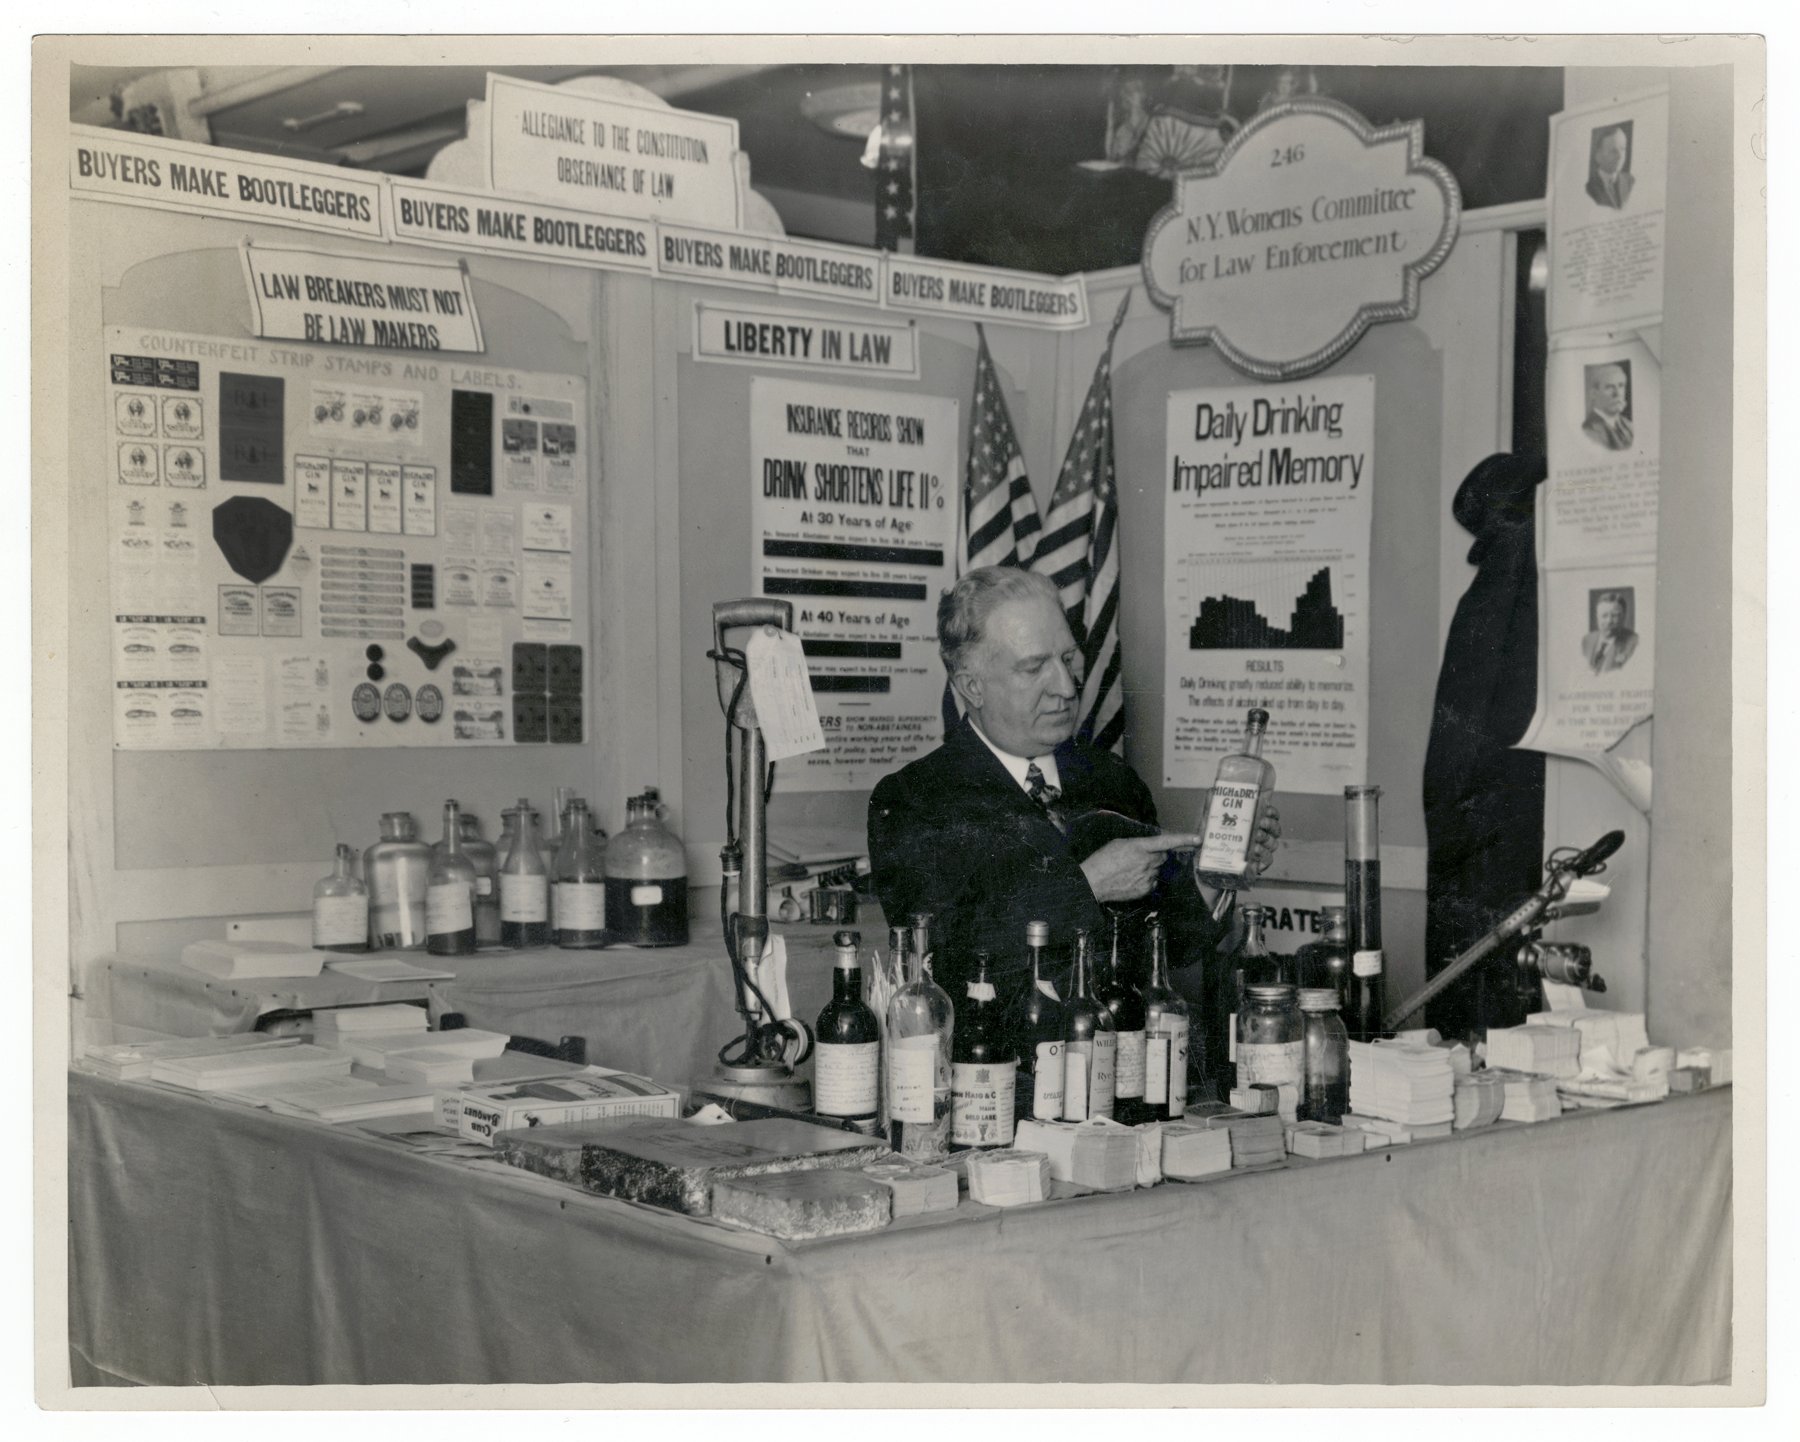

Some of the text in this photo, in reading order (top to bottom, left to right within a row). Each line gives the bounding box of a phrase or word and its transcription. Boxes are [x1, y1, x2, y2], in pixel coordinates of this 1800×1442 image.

[522, 110, 708, 164] ALLEGIANCE TO THE CONSTITUTION
[1270, 144, 1305, 168] 246
[78, 149, 372, 223] BUYERS MAKE BOOTLEGGERS
[557, 156, 674, 199] OBSERVANCE OF LAW
[400, 198, 648, 258] BUYERS MAKE BOOTLEGGERS
[1227, 205, 1304, 239] Womens
[1312, 186, 1416, 223] Committee
[664, 235, 874, 291] BUYERS MAKE BOOTLEGGERS
[1179, 227, 1408, 285] for Law Enforcement
[260, 273, 464, 317] LAW BREAKERS MUST NOT
[893, 272, 1078, 316] BUYERS MAKE BOOTLEGGERS
[304, 313, 440, 349] BE LAW MAKERS
[724, 319, 892, 364] LIBERTY IN LAW
[140, 335, 257, 362] COUNTERFEIT
[269, 351, 314, 368] STRIP
[324, 356, 392, 377] STAMPS
[403, 364, 438, 382] AND
[786, 403, 925, 446] INSURANCE RECORDS SHOW
[1195, 395, 1344, 447] Daily Drinking
[846, 445, 870, 457] THAT
[1173, 447, 1365, 498] Impaired Memory
[763, 457, 808, 500] DRINK
[814, 463, 883, 505] SHORTENS
[889, 469, 915, 509] LIFE
[800, 511, 912, 533] At 30 Years of Age
[800, 610, 910, 629] At 40 Years of Age
[1180, 676, 1196, 692] Daily
[1198, 677, 1227, 692] Drinking
[1228, 677, 1252, 692] greatly
[1255, 678, 1284, 691] reduced
[1286, 678, 1306, 693] ability
[1308, 679, 1316, 691] to
[1245, 660, 1284, 673] RESULTS
[1188, 694, 1200, 708] The
[1202, 695, 1224, 708] effects
[1226, 695, 1234, 707] of
[1235, 696, 1258, 708] alcohol
[1276, 698, 1285, 711] up
[1287, 698, 1304, 709] from
[1305, 698, 1320, 712] day
[1321, 699, 1330, 710] to
[1222, 798, 1244, 809] GIN
[464, 1106, 500, 1127] BANQUET
[471, 1122, 491, 1137] CLUB
